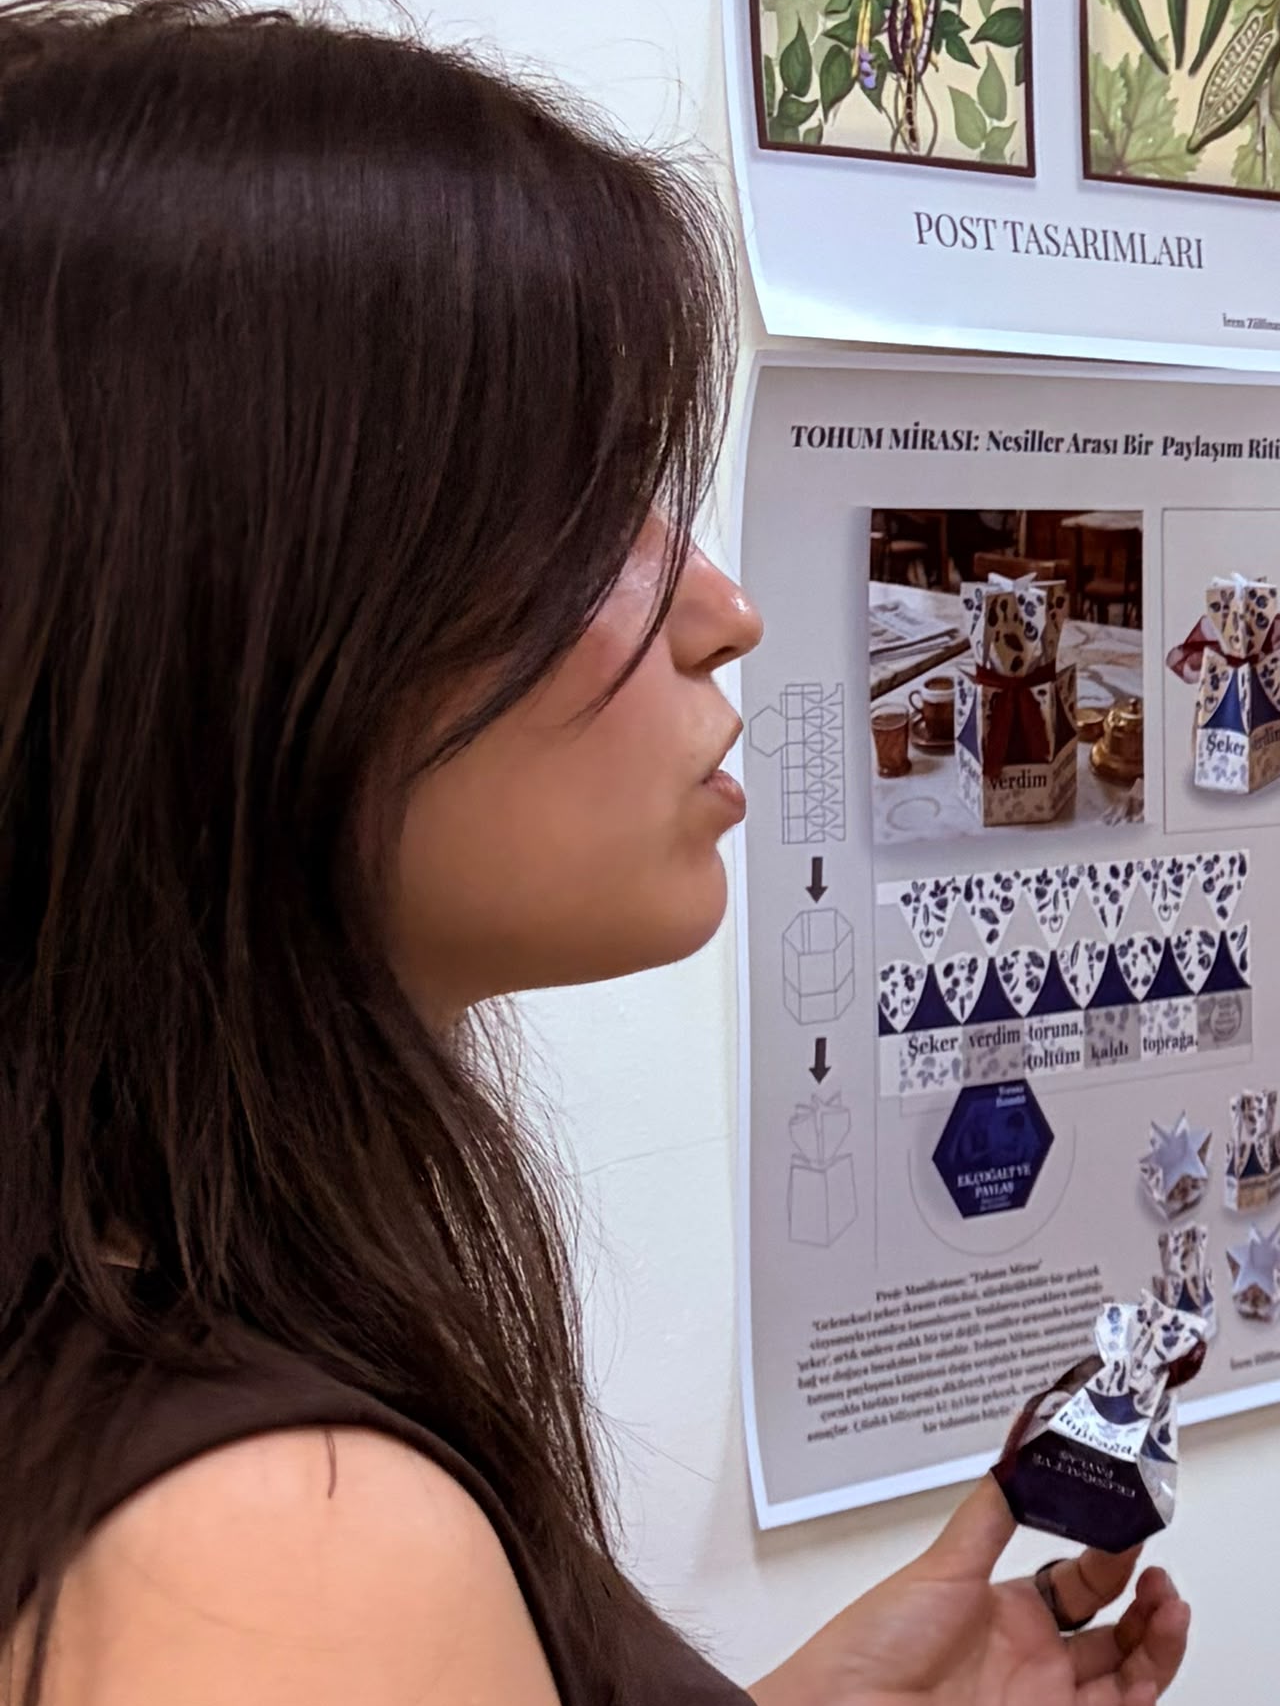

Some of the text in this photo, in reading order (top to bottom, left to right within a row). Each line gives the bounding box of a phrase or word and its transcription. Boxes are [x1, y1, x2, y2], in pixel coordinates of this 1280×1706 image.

[915, 212, 1205, 270] POST TASARIMLARI
[791, 425, 884, 451] TOHUM
[889, 421, 980, 454] MİRASI:
[985, 430, 1064, 455] Nesiller
[1066, 432, 1119, 458] Arası
[1123, 433, 1155, 458] Bir
[1161, 435, 1244, 463] Paylaşım
[908, 1034, 959, 1060] Şeker
[969, 1027, 1021, 1048] verdim
[1091, 1042, 1129, 1061] kaldı
